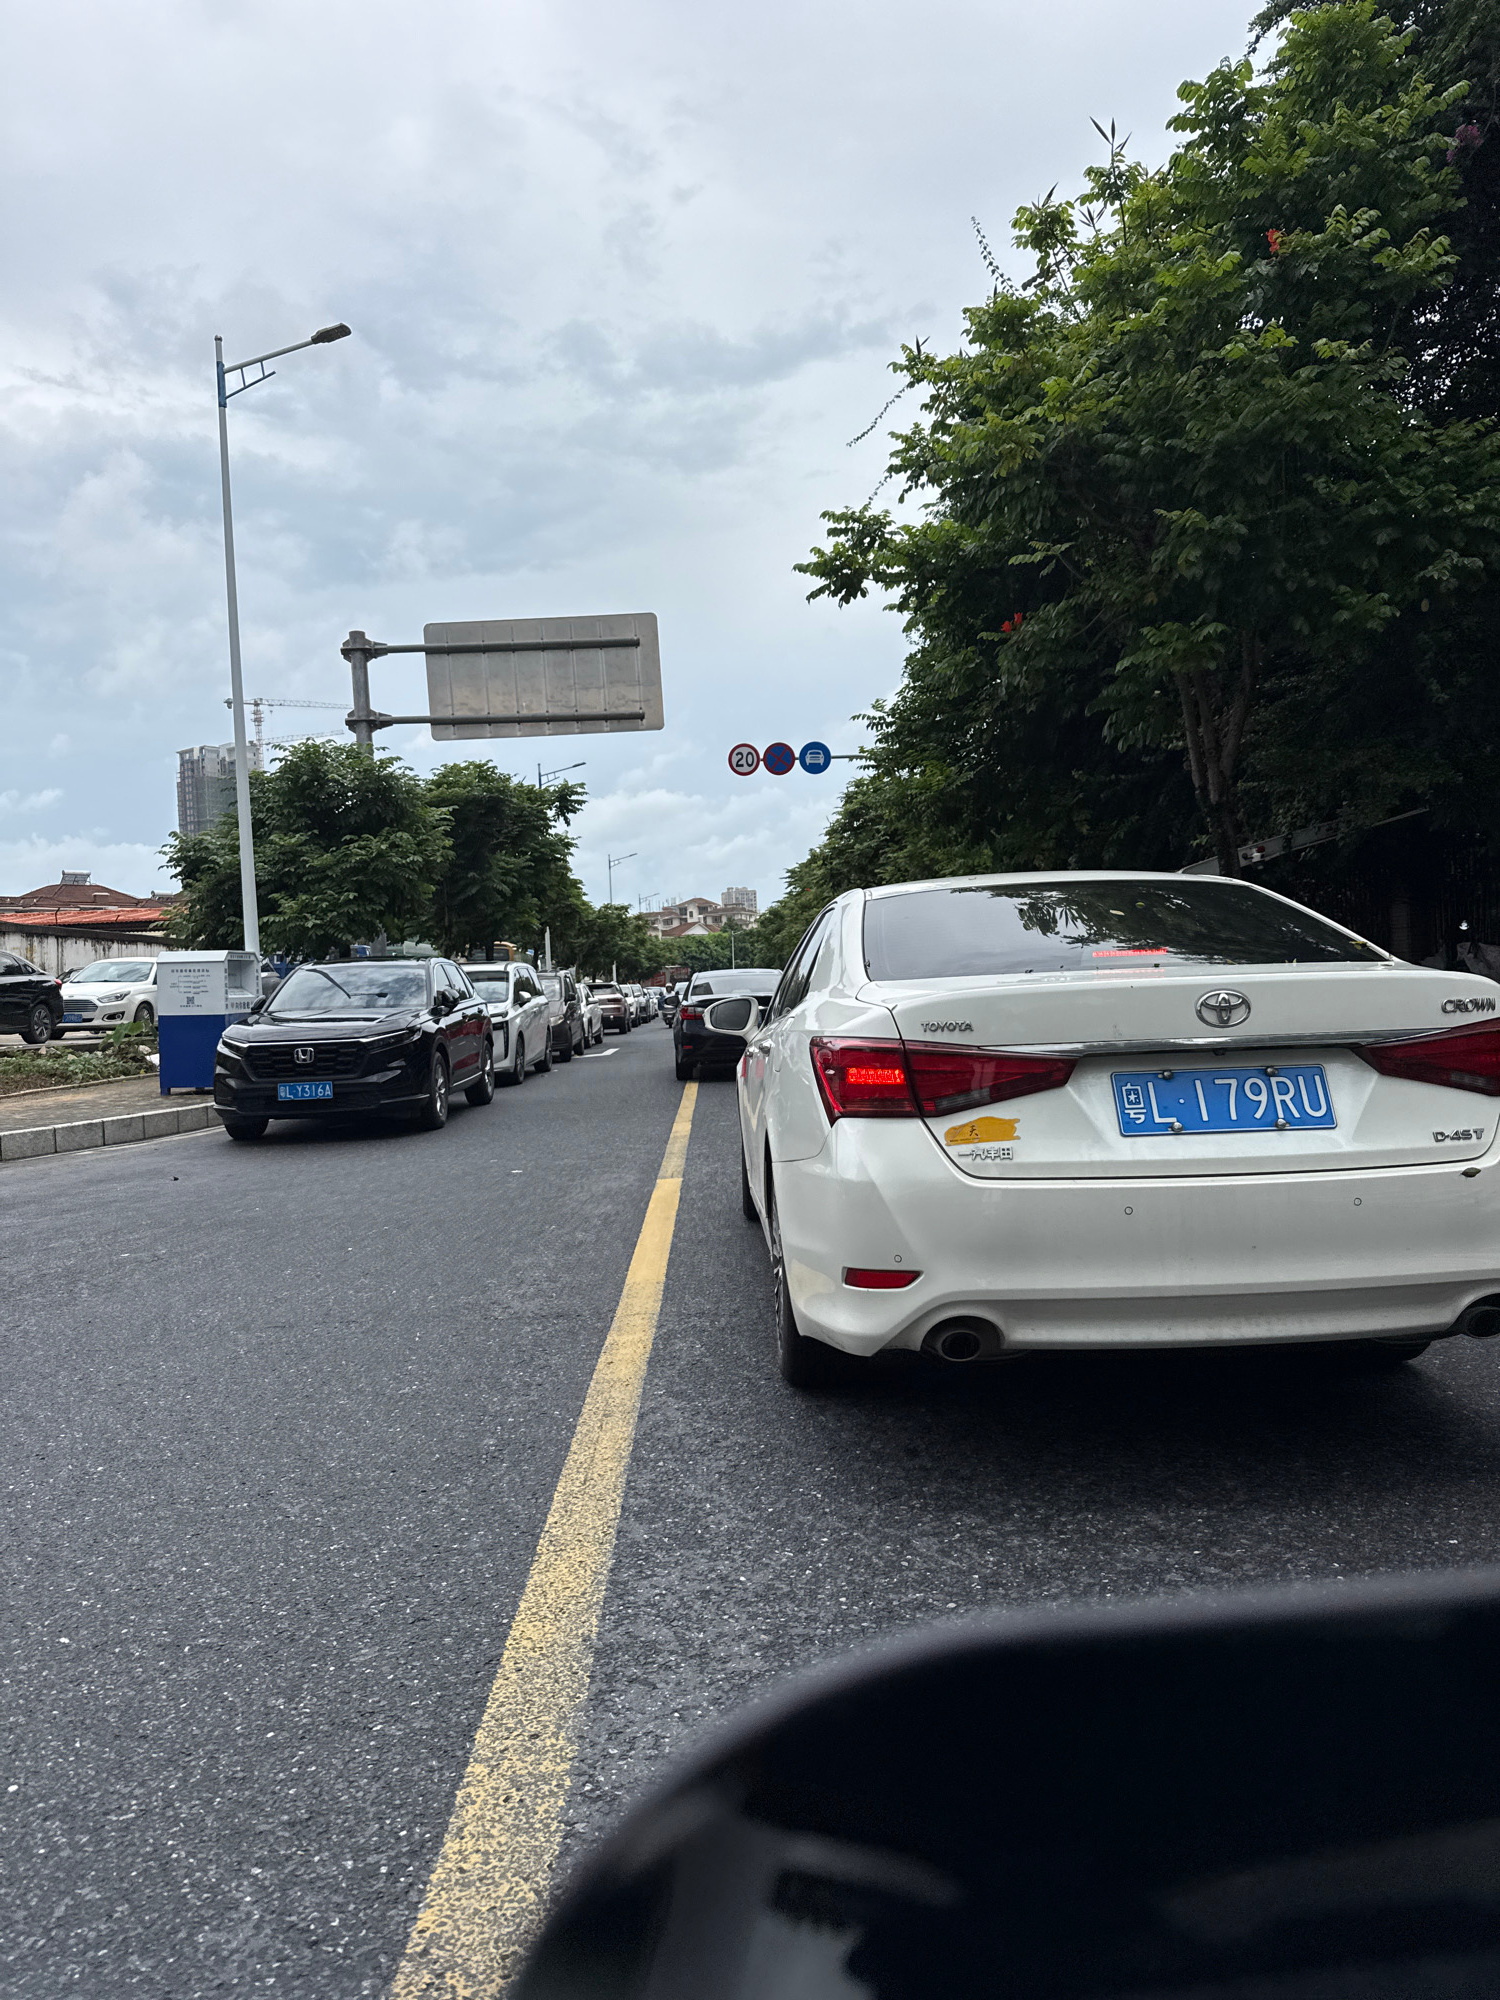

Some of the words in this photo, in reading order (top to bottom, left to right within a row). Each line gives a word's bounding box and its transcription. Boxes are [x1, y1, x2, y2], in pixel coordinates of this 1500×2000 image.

[735, 751, 755, 768] 20
[1441, 998, 1496, 1013] CROWN
[921, 1020, 974, 1033] TOYOTA
[958, 1147, 1013, 1161] 一汽丰田
